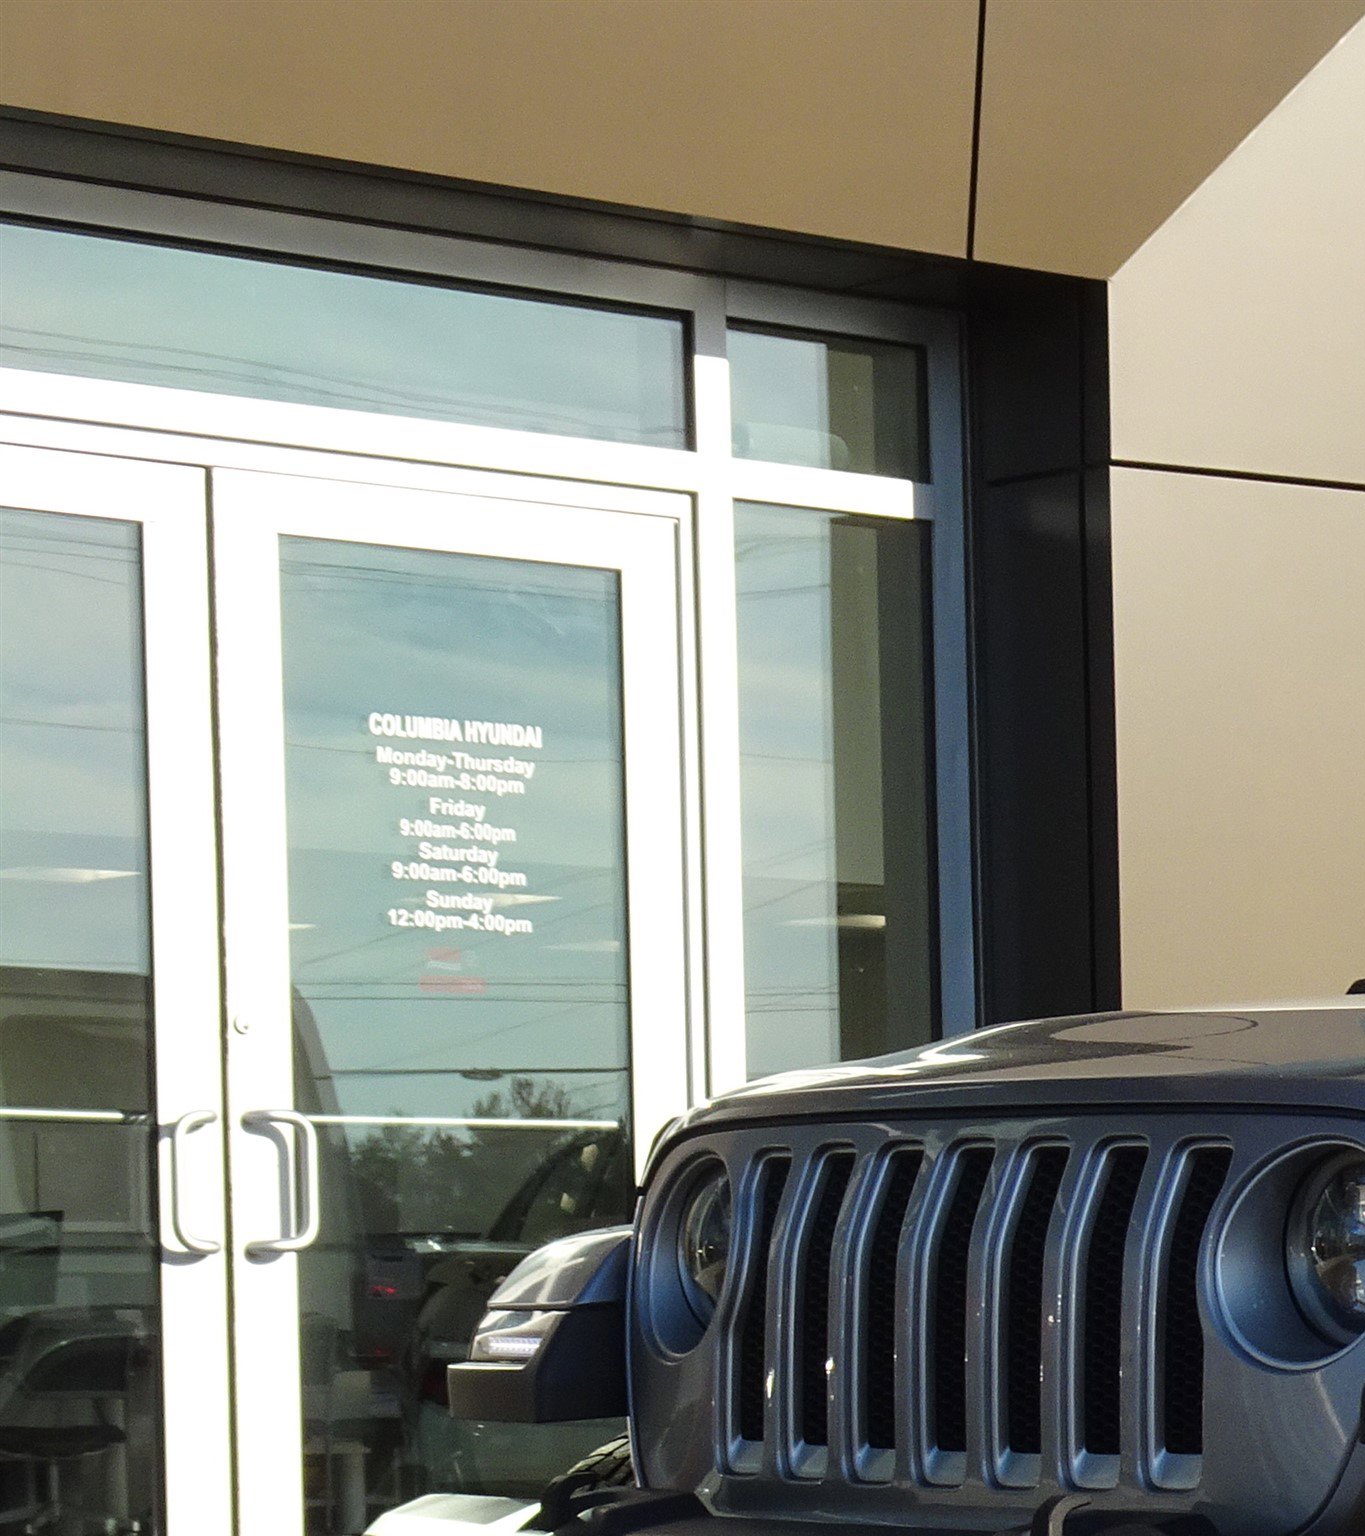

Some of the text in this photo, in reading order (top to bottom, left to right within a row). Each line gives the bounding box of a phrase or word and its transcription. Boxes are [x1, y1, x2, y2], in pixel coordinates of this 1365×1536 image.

[369, 712, 543, 748] COLUMBIA HYUNDAI
[376, 746, 535, 778] Monday-Thursday
[429, 798, 486, 821] Friday
[418, 842, 499, 868] Saturday
[391, 862, 527, 888] 9:00am-6:00pm
[426, 890, 493, 914] Sunday
